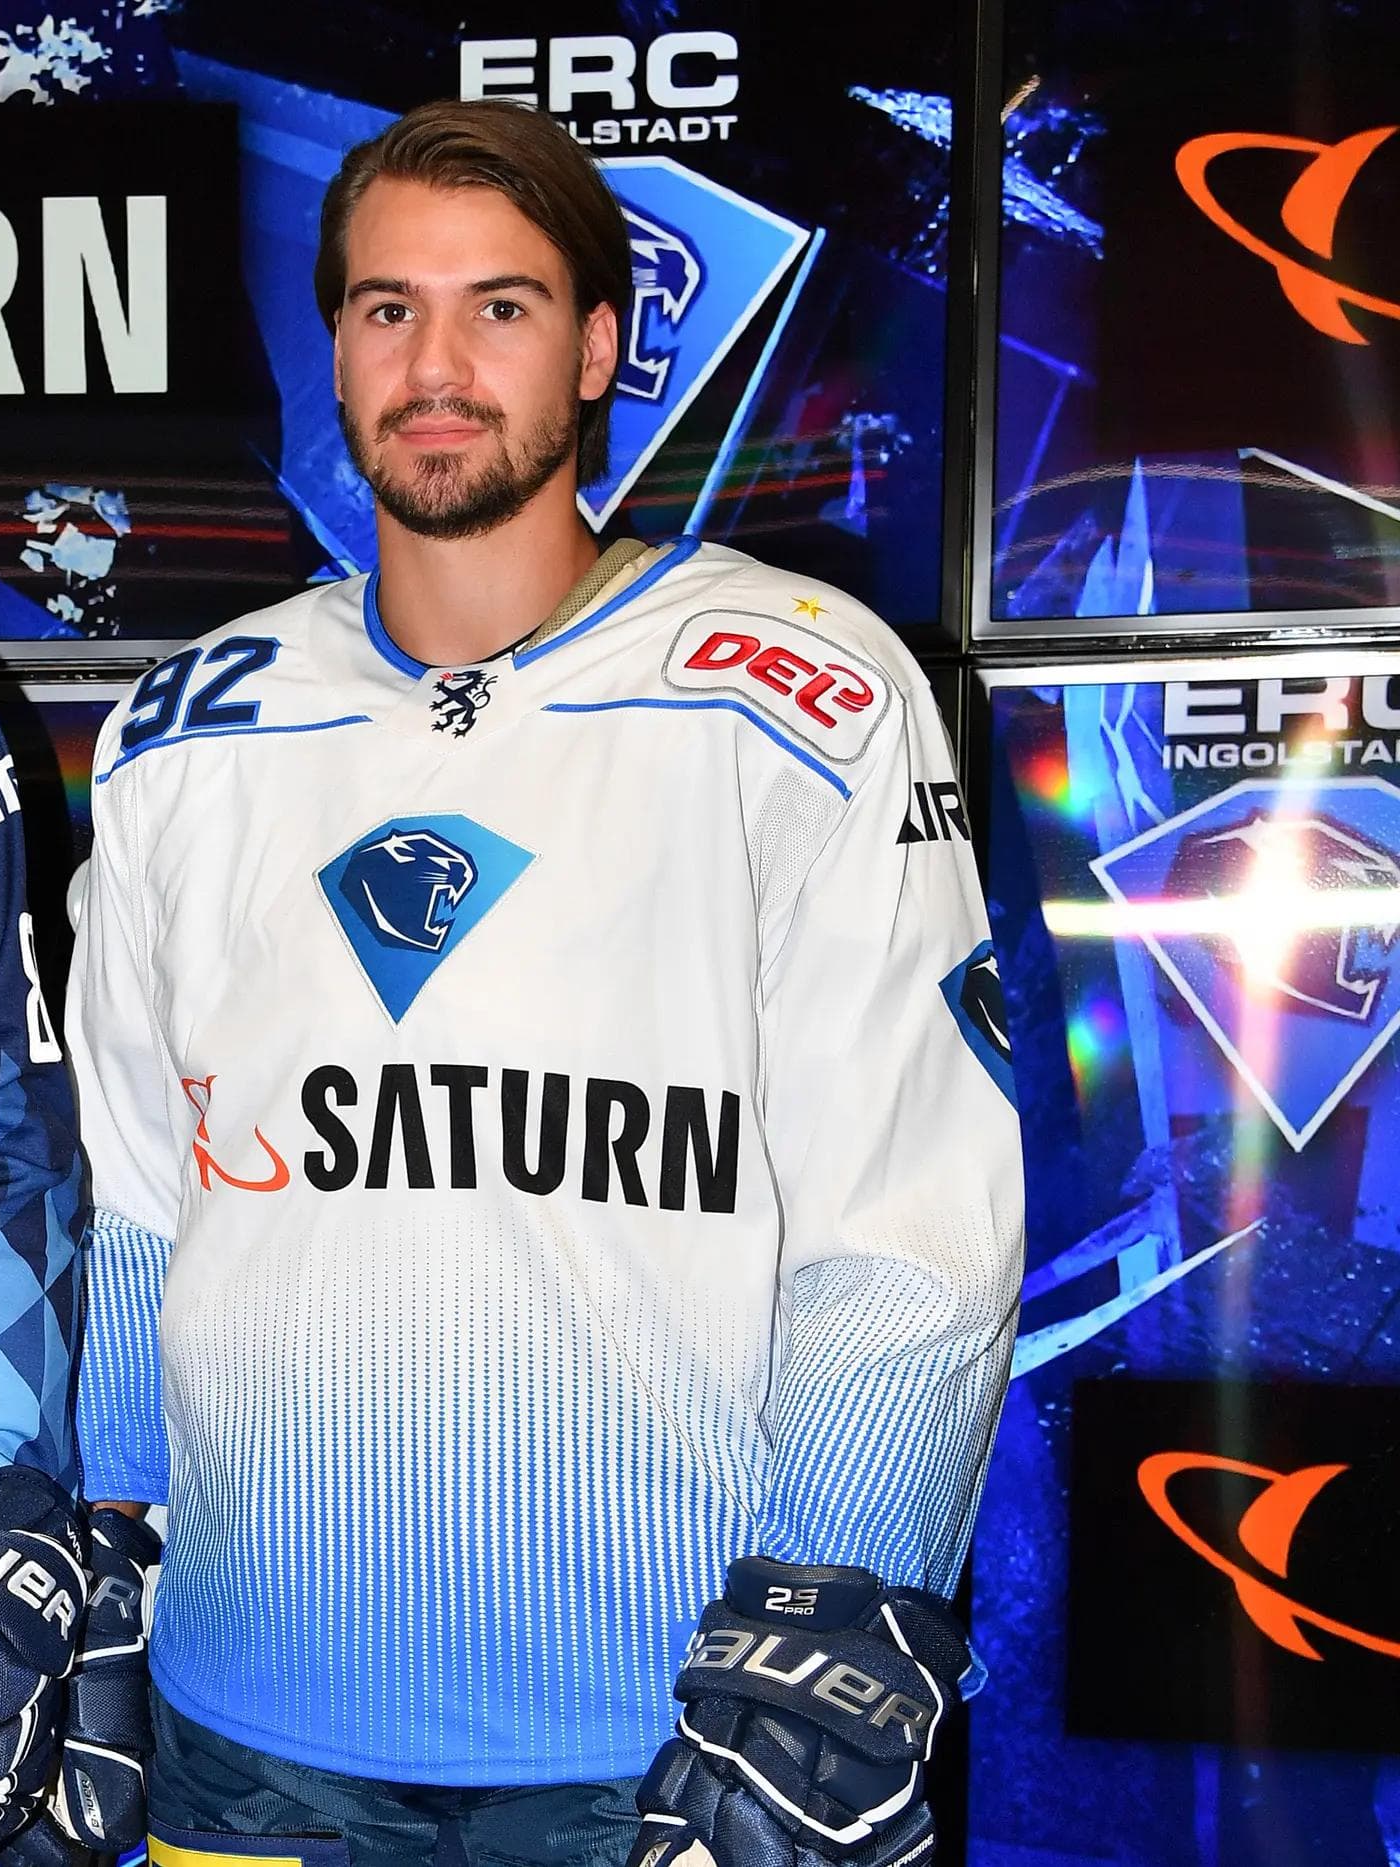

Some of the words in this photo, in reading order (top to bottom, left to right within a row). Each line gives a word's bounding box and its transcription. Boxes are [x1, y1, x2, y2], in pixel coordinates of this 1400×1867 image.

[460, 32, 739, 112] ERC
[556, 115, 738, 146] LSTADT
[119, 635, 283, 756] 92
[1162, 739, 1400, 771] INGOLSTA
[301, 1063, 741, 1215] SATURN
[783, 1606, 815, 1616] PRO
